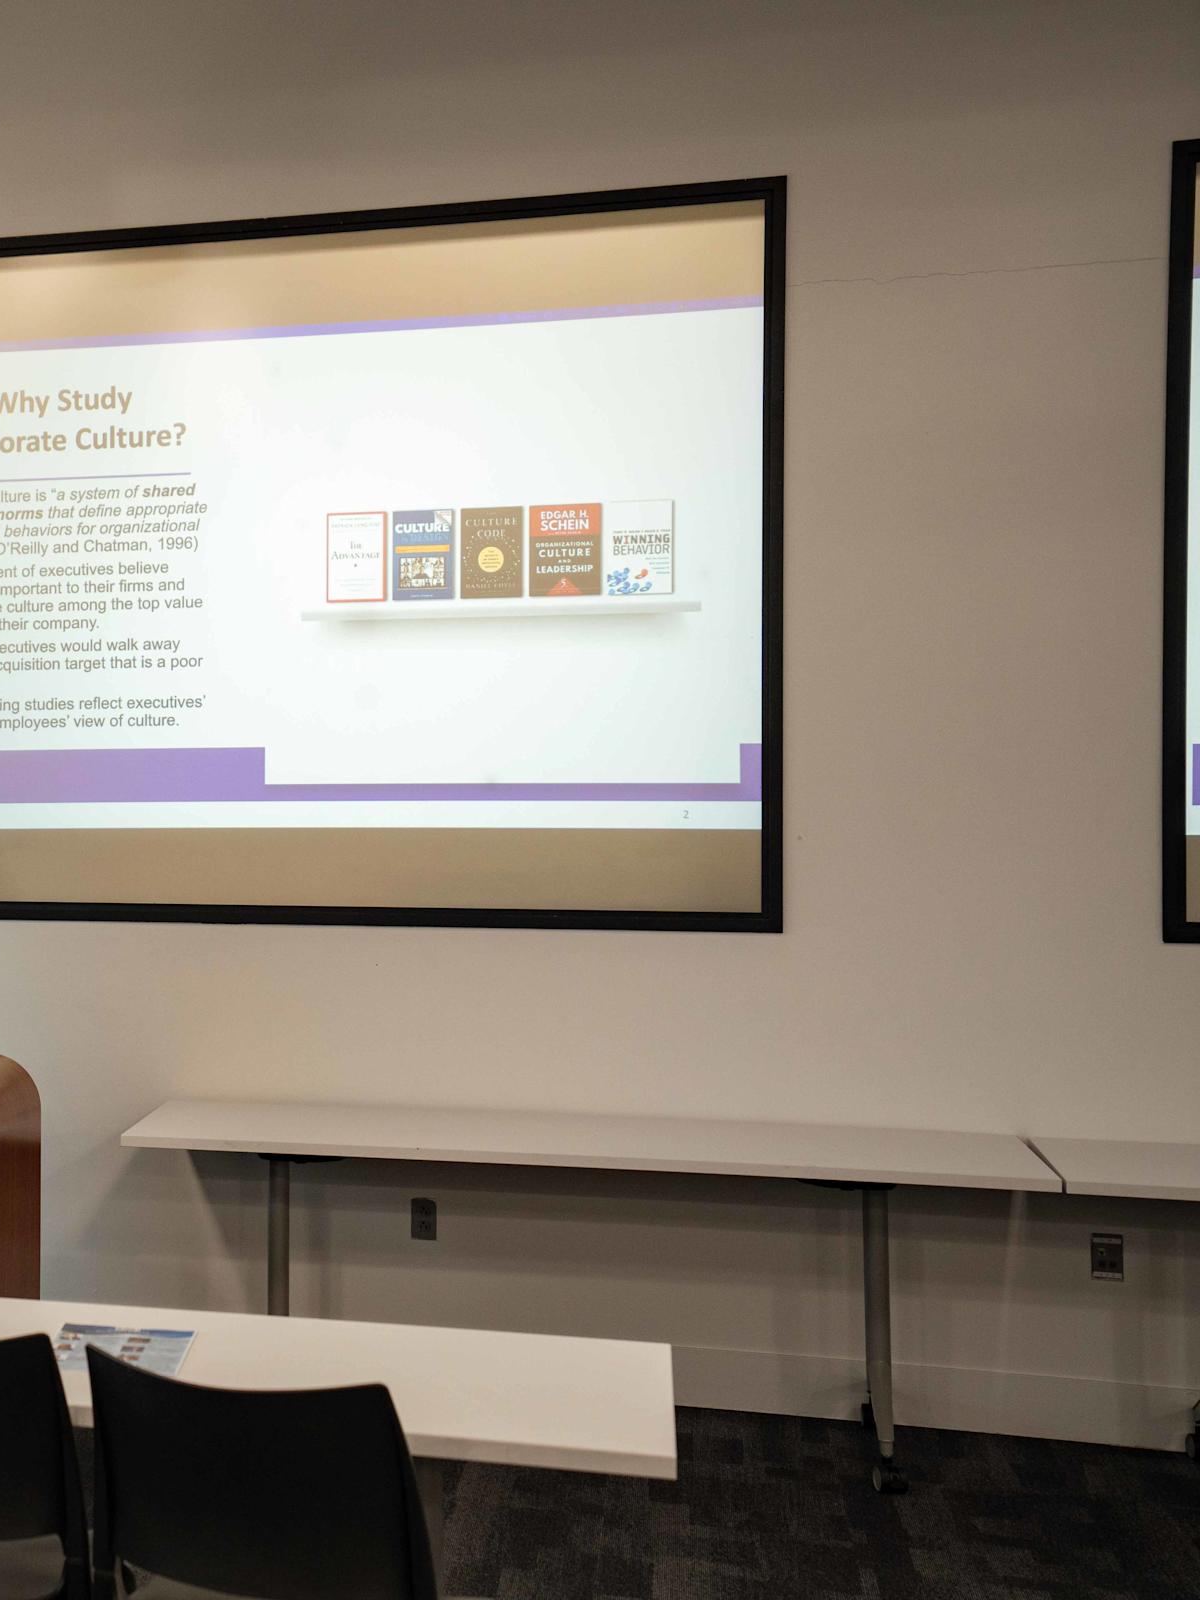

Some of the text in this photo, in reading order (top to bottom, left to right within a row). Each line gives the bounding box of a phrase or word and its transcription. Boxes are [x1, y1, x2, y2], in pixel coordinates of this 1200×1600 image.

[57, 387, 132, 417] Study
[75, 423, 186, 451] Culture?
[35, 488, 47, 502] is
[69, 485, 120, 503] system
[124, 485, 138, 499] of
[142, 483, 196, 498] shared
[48, 505, 74, 519] that
[78, 503, 121, 518] define
[126, 500, 207, 519] appropriate
[540, 510, 576, 520] EDGAR
[3, 522, 72, 538] behaviors
[76, 521, 96, 536] for
[99, 518, 200, 538] organizational
[395, 523, 450, 534] CULTURE
[465, 517, 518, 527] CULTURE
[540, 518, 589, 531] SCHEIN
[52, 540, 78, 554] and
[83, 538, 151, 556] Chatman,
[157, 537, 198, 554] 1996)
[612, 533, 670, 545] WINNING
[538, 547, 591, 558] CULTURE
[612, 543, 670, 556] BEHAVIOR
[21, 564, 35, 578] of
[39, 562, 113, 577] executives
[118, 560, 168, 575] believe
[536, 564, 594, 574] LEADERSHIP
[66, 580, 79, 594] to
[83, 579, 115, 594] their
[118, 578, 153, 593] firms
[158, 578, 184, 592] and
[6, 599, 53, 614] culture
[58, 600, 106, 615] among
[110, 597, 133, 611] the
[137, 596, 159, 613] top
[164, 595, 203, 610] value
[32, 618, 99, 633] company.
[60, 638, 101, 653] would
[106, 637, 138, 652] walk
[142, 639, 180, 654] away
[64, 656, 105, 673] target
[109, 655, 136, 669] that
[141, 655, 152, 669] is
[157, 657, 165, 669] a
[170, 656, 203, 671] poor
[24, 696, 74, 711] studies
[79, 695, 123, 710] reflect
[73, 714, 105, 728] view
[109, 714, 123, 728] of
[127, 713, 179, 727] culture.
[682, 809, 689, 819] 2
